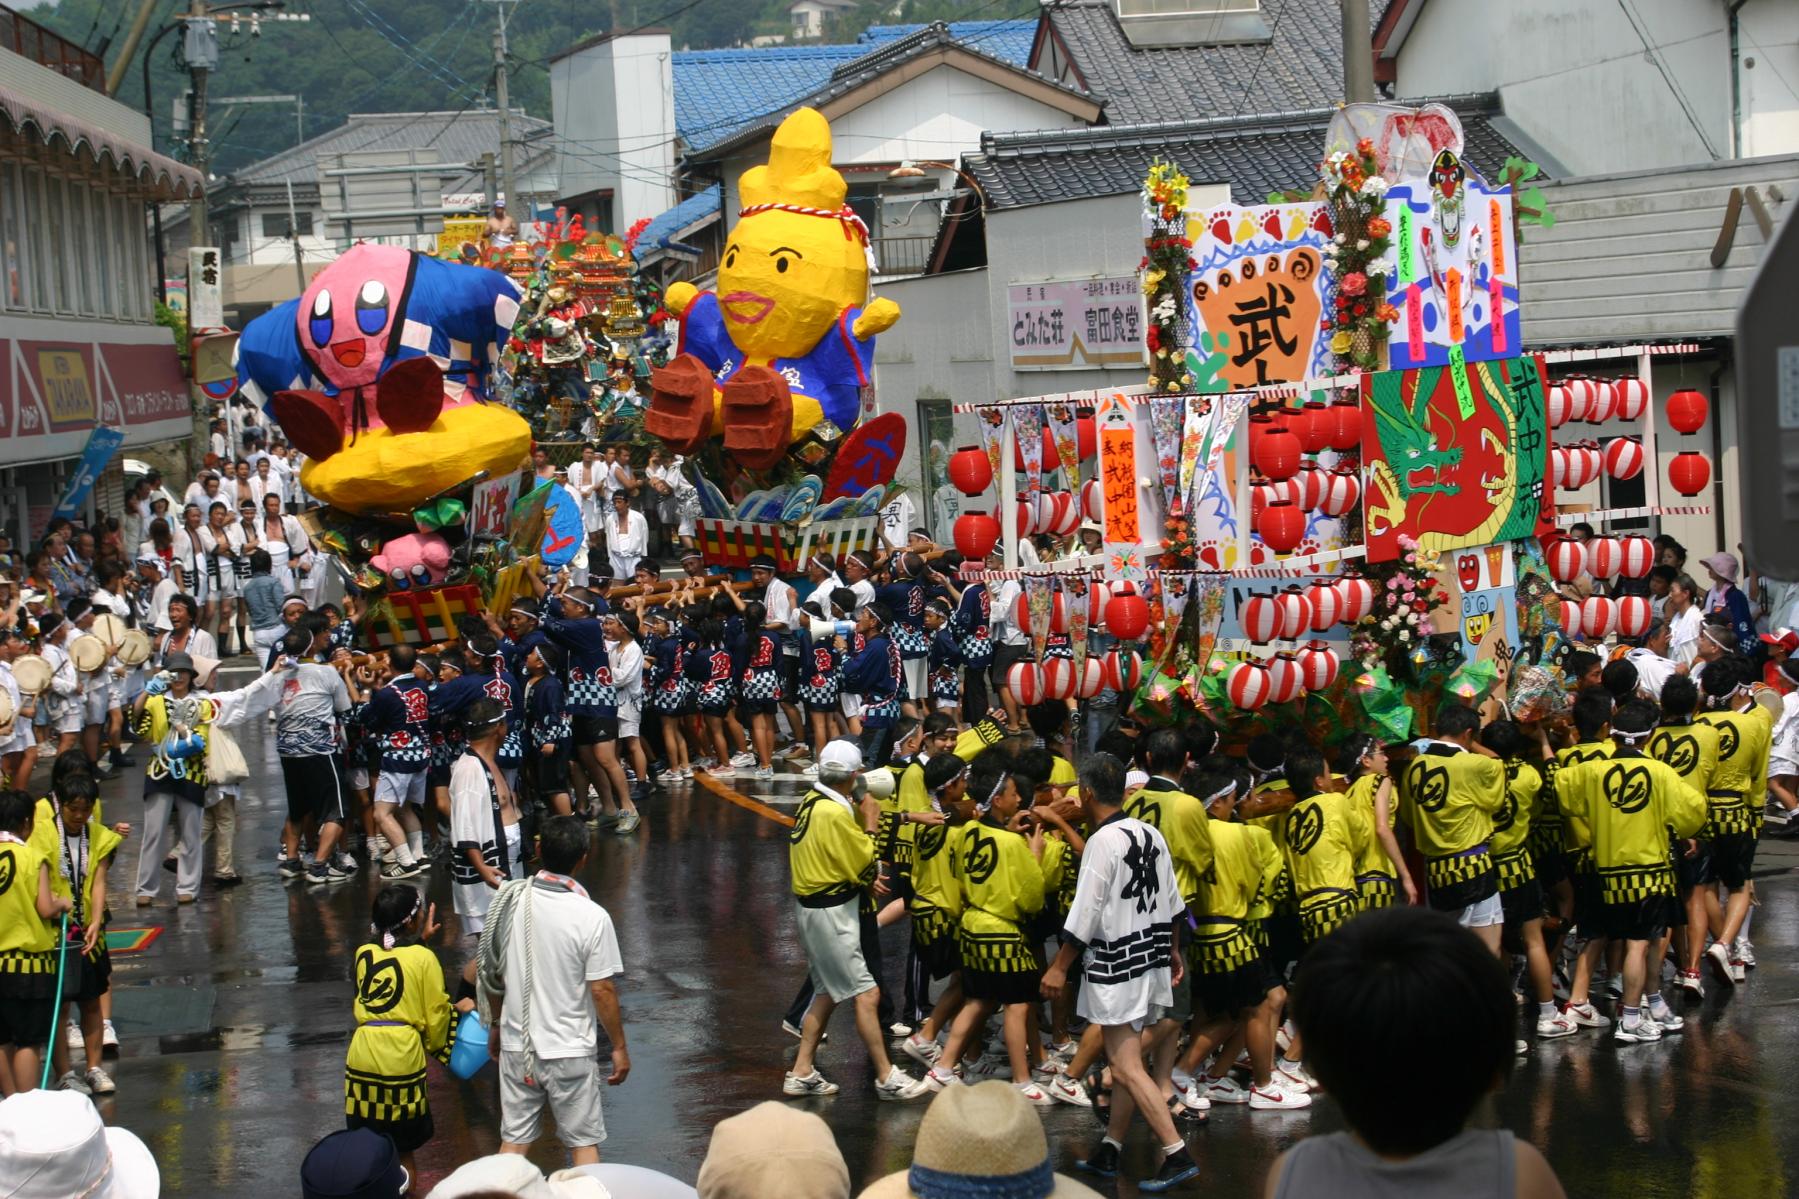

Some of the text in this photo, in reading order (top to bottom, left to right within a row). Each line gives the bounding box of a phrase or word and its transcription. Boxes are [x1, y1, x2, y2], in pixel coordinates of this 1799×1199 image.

[1013, 308, 1065, 346] とみた荘
[1085, 304, 1140, 344] 富田食堂
